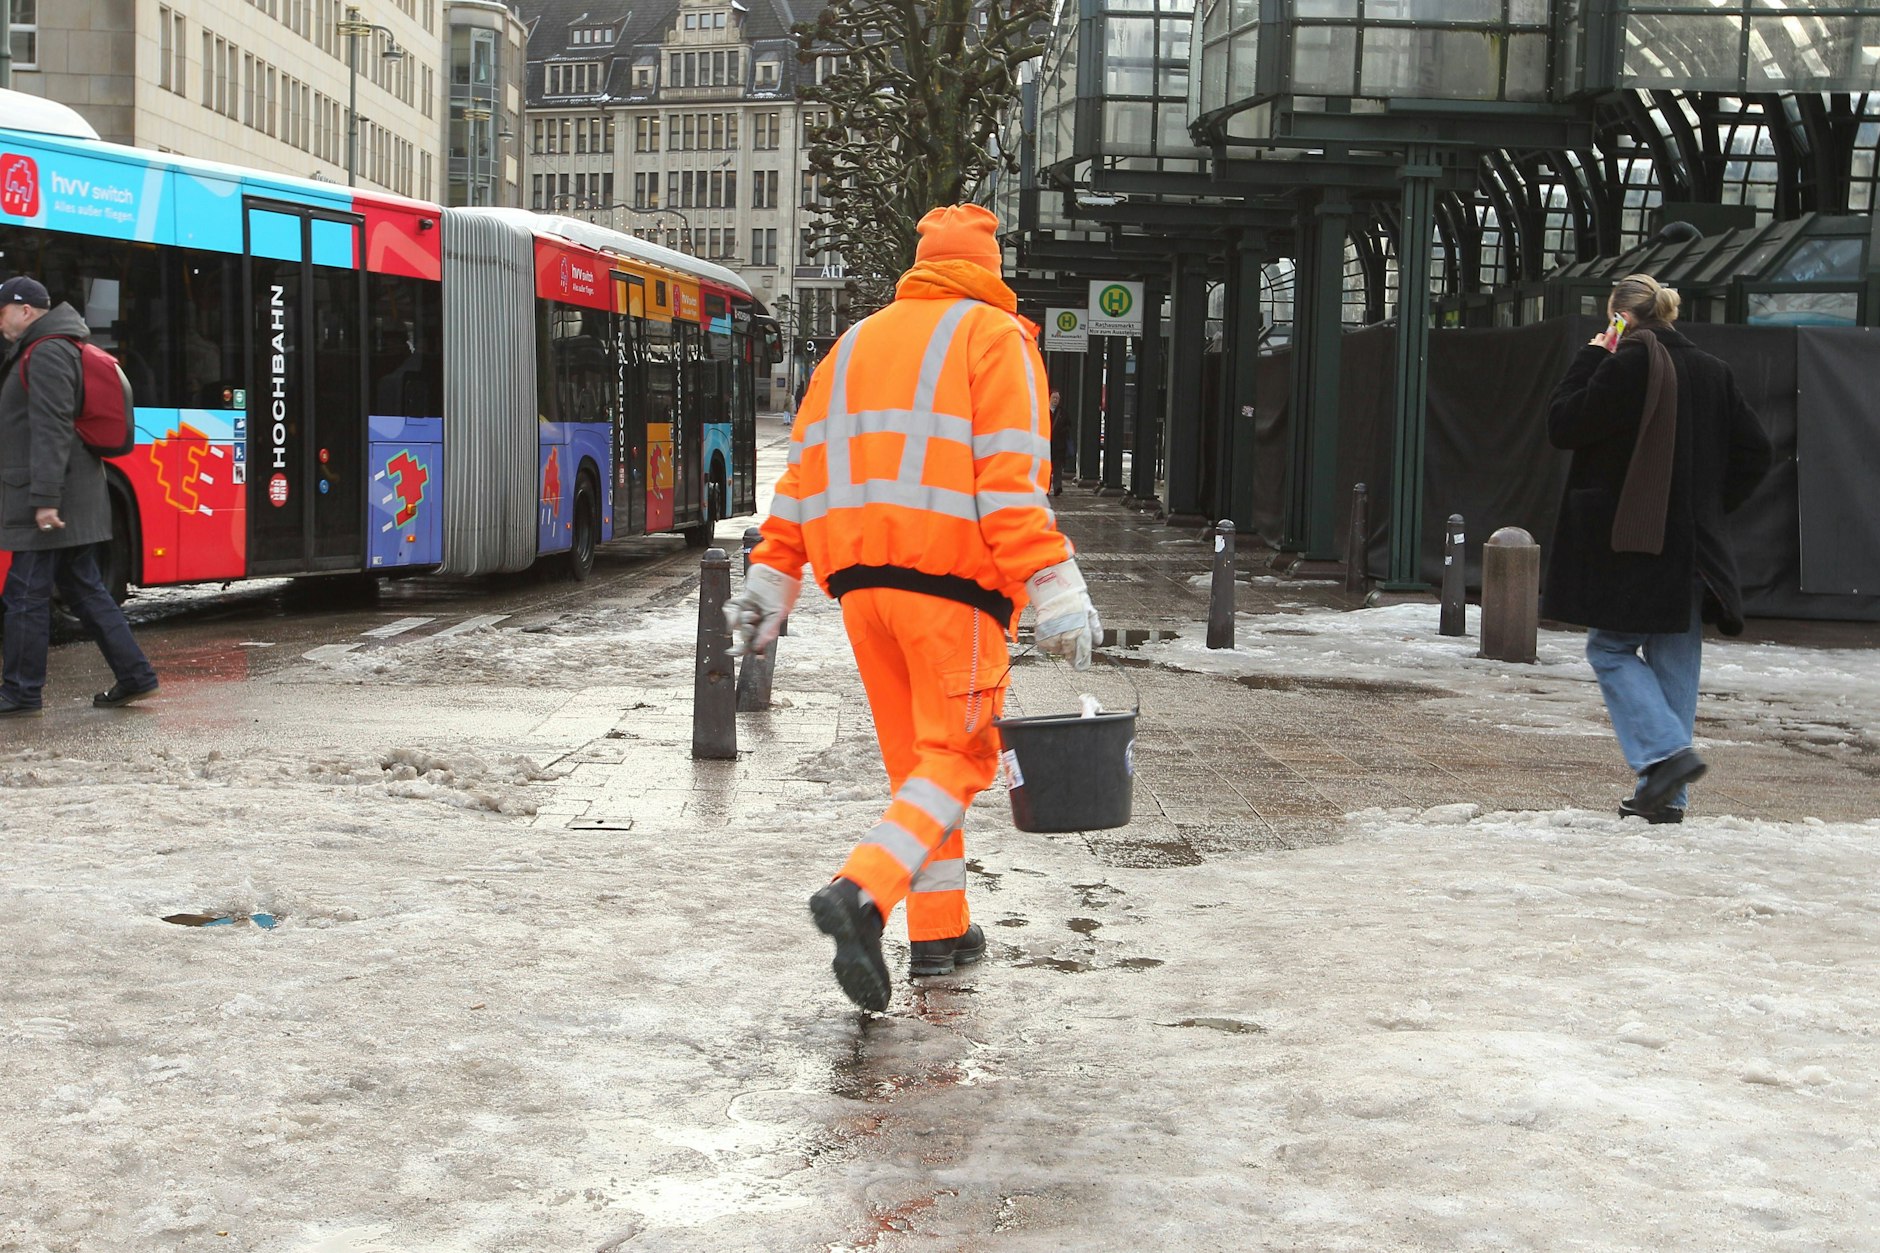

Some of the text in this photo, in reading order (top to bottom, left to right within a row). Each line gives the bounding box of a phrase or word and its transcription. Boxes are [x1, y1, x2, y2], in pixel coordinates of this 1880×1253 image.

[51, 170, 134, 205] hvv switch
[54, 200, 76, 214] Alles
[78, 204, 103, 217] außer
[571, 263, 594, 283] hvv switch
[1112, 329, 1142, 337] Aussteigen
[271, 285, 286, 468] HOCHBAHN
